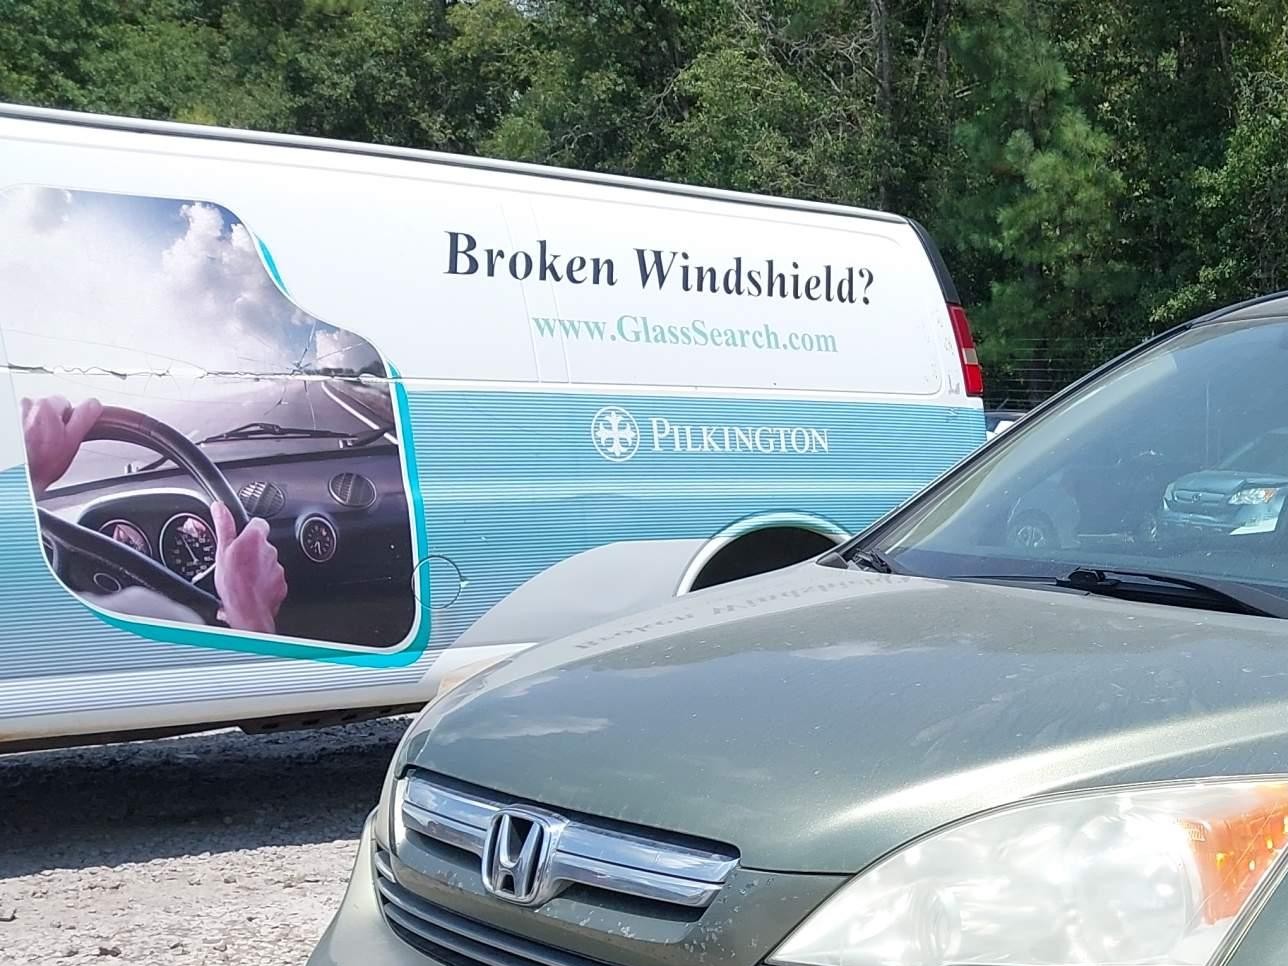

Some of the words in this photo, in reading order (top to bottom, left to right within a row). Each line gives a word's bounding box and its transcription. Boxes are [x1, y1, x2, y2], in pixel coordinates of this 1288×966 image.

[445, 231, 618, 286] Broken
[635, 248, 875, 305] Windshield?
[532, 315, 838, 353] www.GlassSearch.com
[650, 416, 830, 453] PILKINGTON
